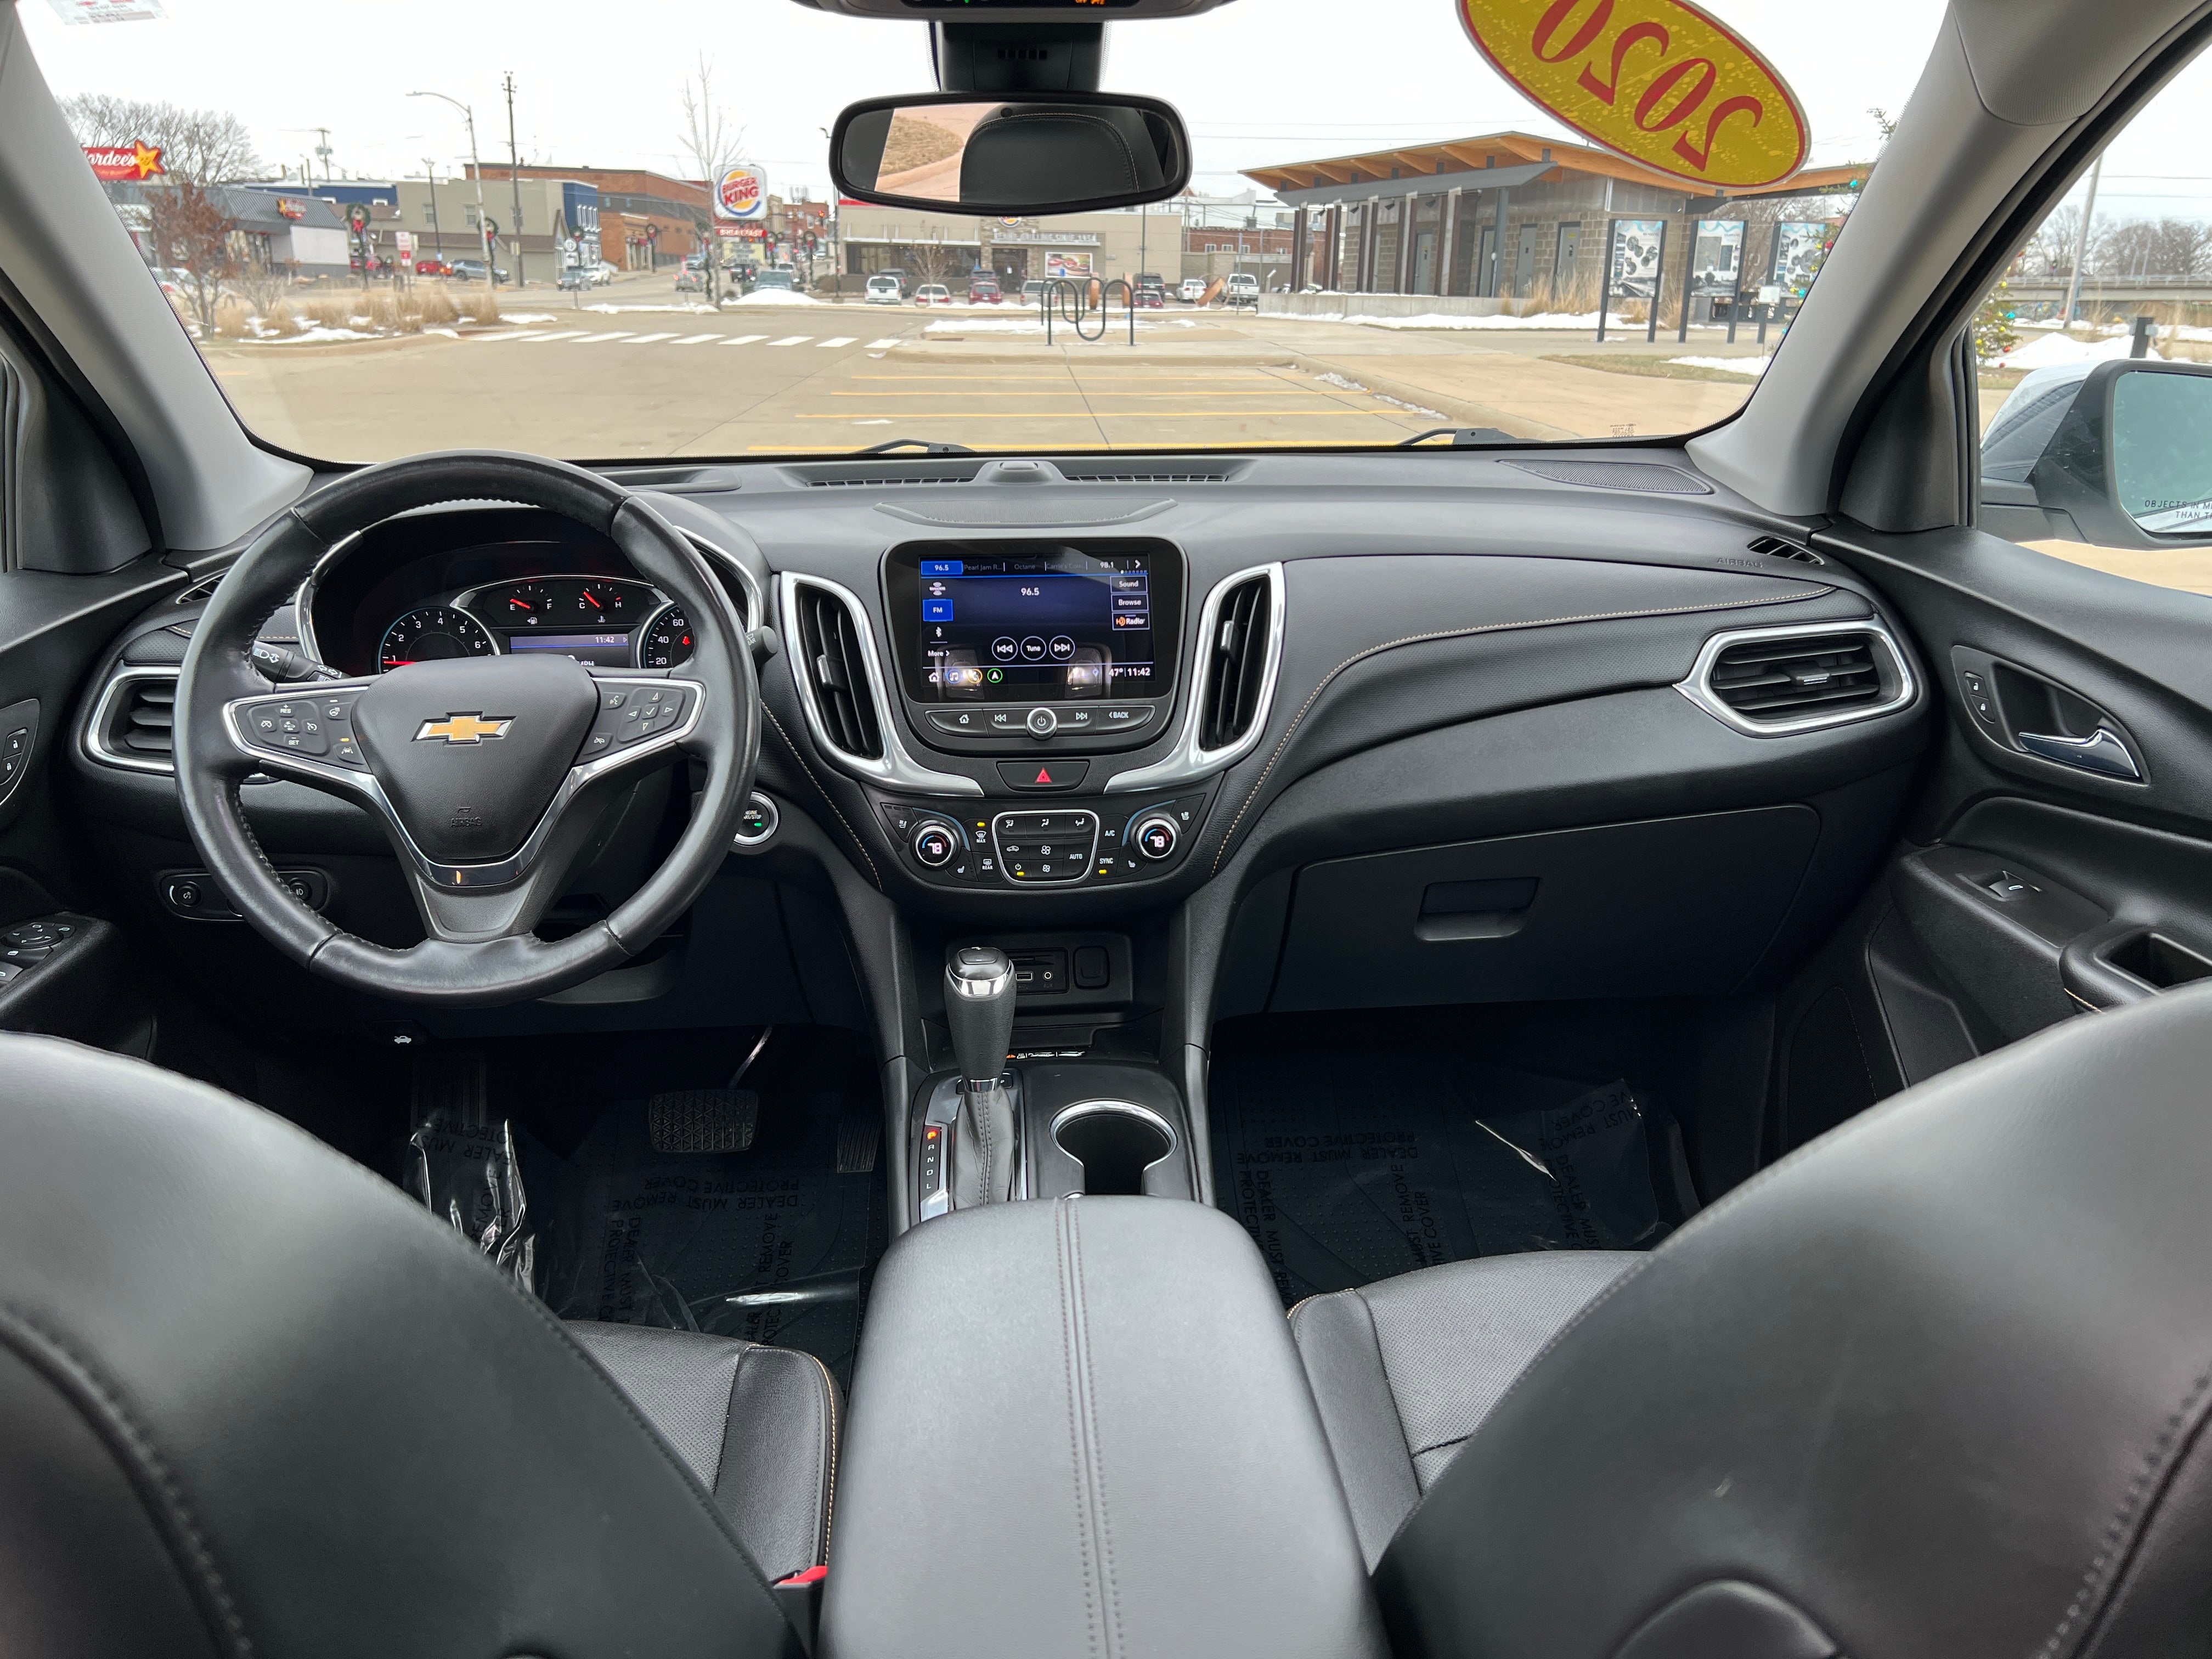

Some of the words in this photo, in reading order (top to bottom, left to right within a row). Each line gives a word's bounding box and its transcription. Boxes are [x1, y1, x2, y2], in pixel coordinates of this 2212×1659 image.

[722, 177, 757, 194] BURGER
[724, 186, 759, 206] KING
[2145, 500, 2187, 508] OBJECTS
[2176, 511, 2200, 519] THAN
[1717, 557, 1763, 568] AIRBAG
[1020, 587, 1040, 596] 96.5
[415, 620, 421, 629] 3
[398, 634, 404, 642] 2
[747, 637, 757, 646] EAR
[1127, 667, 1151, 676] 11:42
[927, 842, 942, 854] 78
[1150, 836, 1165, 848] 78
[1551, 1100, 1605, 1131] COVER
[927, 1130, 937, 1140] P
[1264, 1135, 1319, 1148] COVER
[1324, 1131, 1415, 1145] PROTECTIVE
[1237, 1152, 1303, 1164] REMOVE
[1312, 1149, 1352, 1163] MUST
[1361, 1147, 1418, 1160] DEALER
[645, 1176, 698, 1193] COVER
[704, 1178, 800, 1194] PROTECTIVE
[1556, 1154, 1586, 1210] DEALER
[1390, 1164, 1414, 1222] REMOVE
[612, 1191, 676, 1212] REMOVE
[686, 1196, 728, 1212] MUST
[738, 1195, 798, 1209] DEALER
[1256, 1170, 1276, 1221] DEALER
[1266, 1230, 1284, 1265] MUST
[1414, 1190, 1437, 1238] COVER
[622, 1216, 641, 1263] DEALER
[758, 1212, 778, 1273] REMOVE
[600, 1220, 624, 1300] PROTECTIVE
[619, 1272, 635, 1310] MUST
